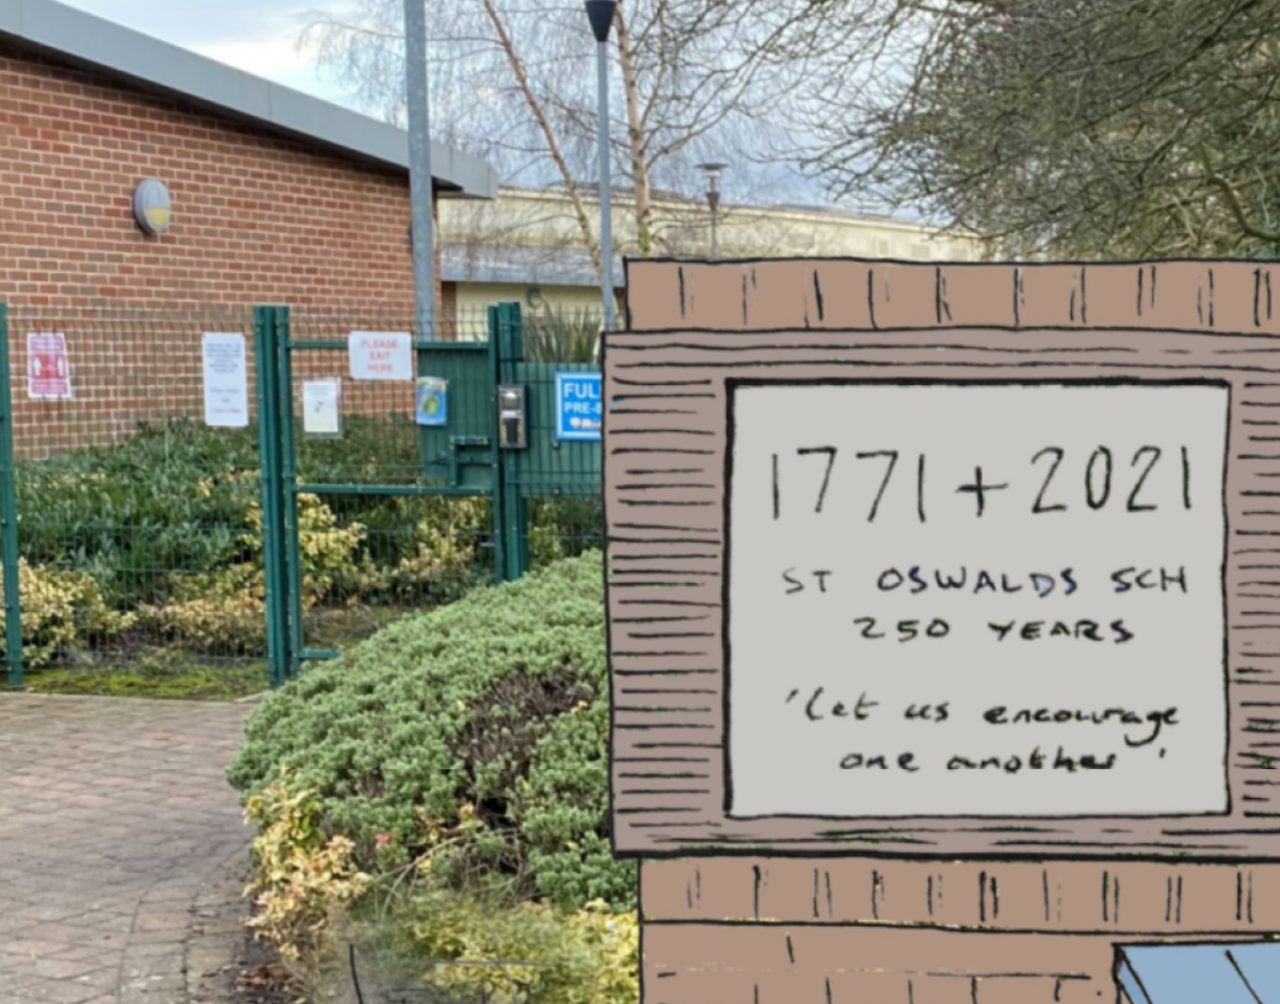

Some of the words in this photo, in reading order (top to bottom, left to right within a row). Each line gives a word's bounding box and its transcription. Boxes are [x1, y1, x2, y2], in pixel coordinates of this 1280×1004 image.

[361, 339, 398, 349] PLEASE
[370, 351, 391, 360] EXIT
[368, 364, 393, 373] HERE
[563, 383, 602, 399] FUL
